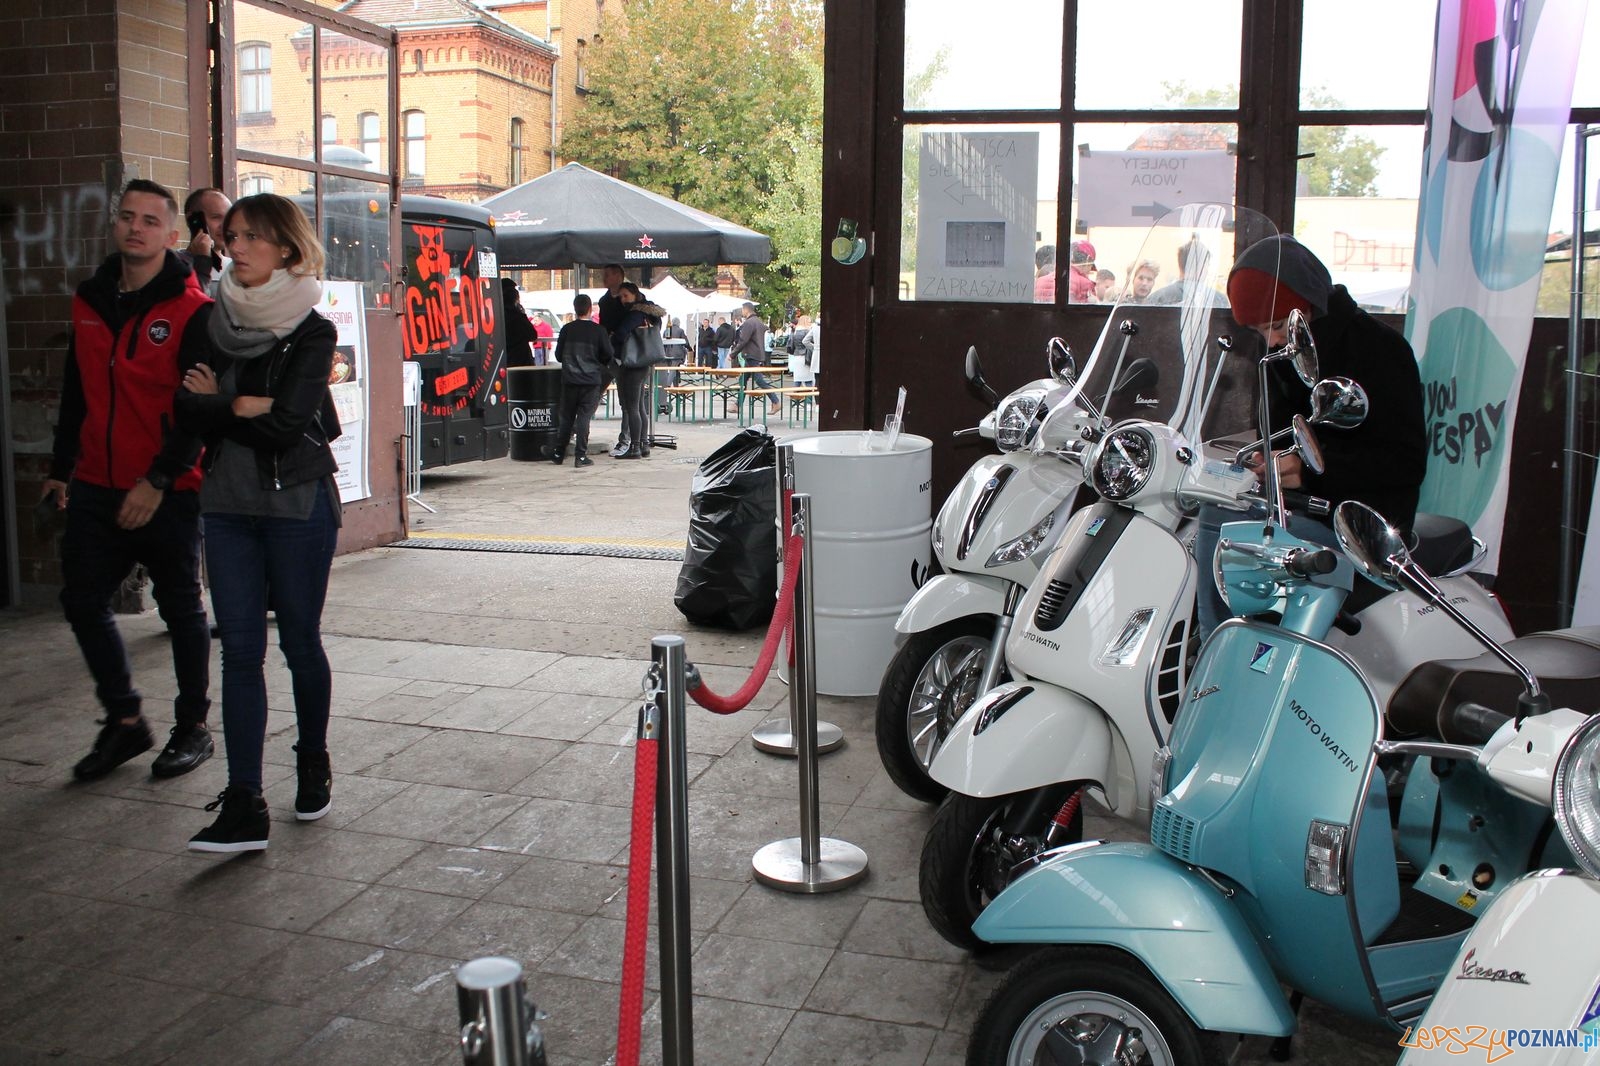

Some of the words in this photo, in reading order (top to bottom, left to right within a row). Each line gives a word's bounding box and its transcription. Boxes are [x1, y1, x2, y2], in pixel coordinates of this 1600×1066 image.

[624, 249, 669, 260] Heineken
[1036, 635, 1061, 651] WATIN
[1289, 699, 1321, 735] MOTO
[1320, 732, 1359, 773] WATIN
[1456, 948, 1531, 985] Vespa
